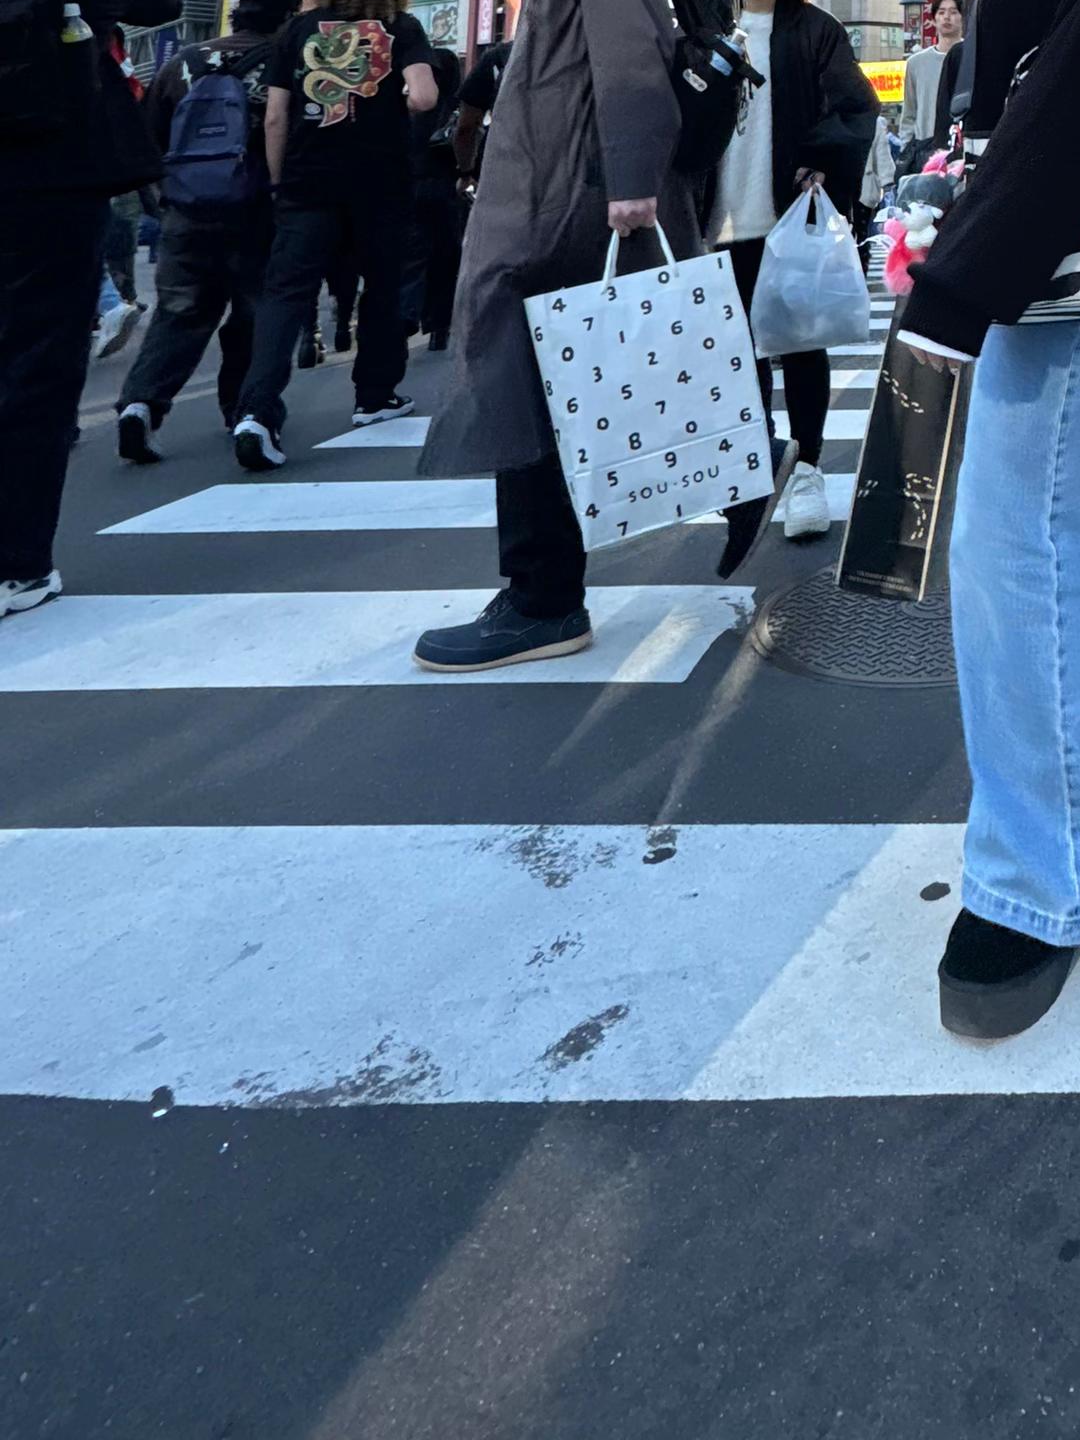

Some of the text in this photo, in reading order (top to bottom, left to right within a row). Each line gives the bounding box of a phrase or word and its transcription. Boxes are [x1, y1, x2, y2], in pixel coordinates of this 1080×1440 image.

[658, 271, 670, 284] 0
[607, 286, 617, 301] 3
[693, 287, 705, 304] 8
[552, 297, 567, 312] 4
[640, 300, 652, 315] 9
[723, 305, 733, 320] 3
[582, 317, 594, 331] 7
[670, 320, 683, 335] 6
[534, 326, 543, 342] 6
[703, 337, 715, 350] 0
[562, 346, 574, 362] 0
[647, 352, 659, 366] 2
[730, 357, 742, 372] 9
[592, 366, 603, 383] 3
[676, 369, 692, 385] 4
[621, 384, 633, 400] 5
[711, 386, 721, 402] 5
[567, 397, 579, 413] 6
[655, 400, 666, 414] 7
[740, 407, 752, 422] 6
[597, 417, 609, 431] 0
[686, 420, 698, 434] 0
[629, 432, 643, 450] 8
[719, 438, 734, 453] 4
[577, 448, 588, 463] 2
[665, 451, 677, 468] 9
[747, 452, 760, 470] 8
[607, 471, 619, 487] 5
[728, 486, 741, 502] 2
[586, 503, 601, 519] 4
[617, 520, 628, 536] 7
